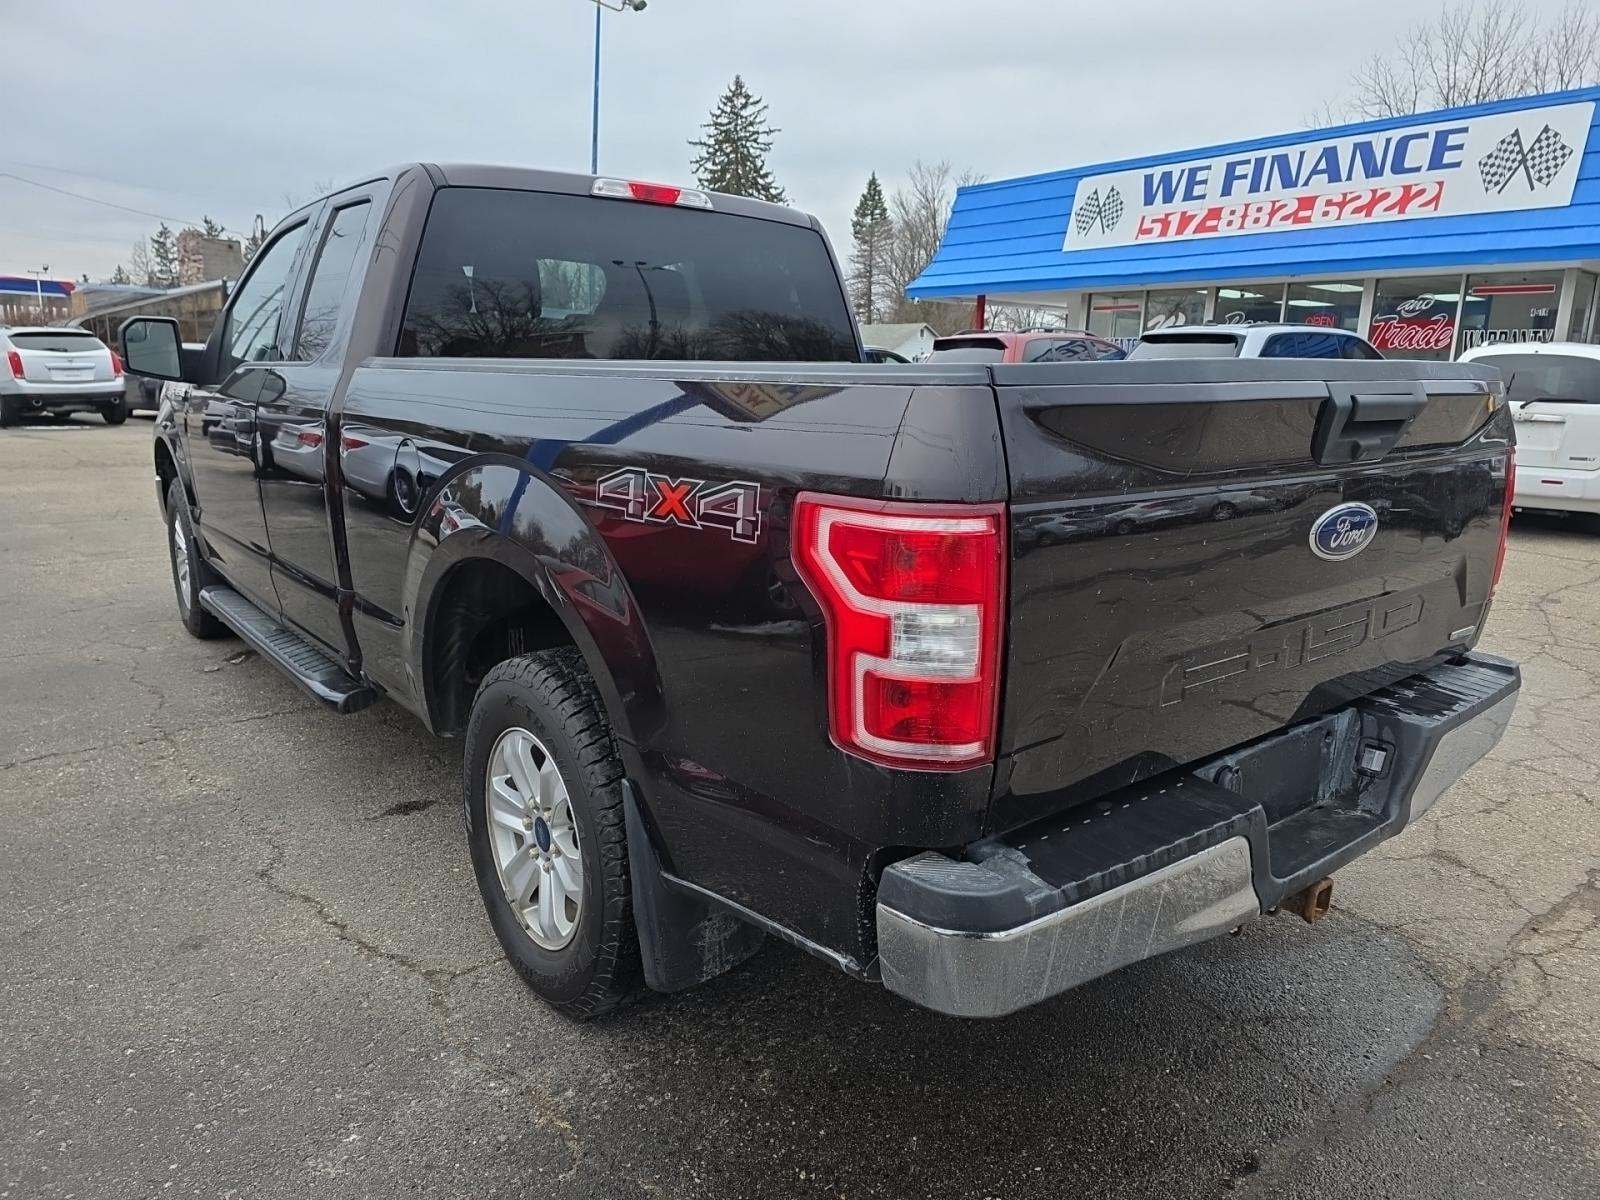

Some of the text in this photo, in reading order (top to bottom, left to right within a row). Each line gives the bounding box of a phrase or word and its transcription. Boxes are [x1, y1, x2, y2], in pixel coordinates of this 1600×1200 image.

[1143, 126, 1469, 207] WE FINANCE
[1137, 181, 1443, 240] 517-882-6222
[1305, 315, 1336, 328] OPEN
[1371, 313, 1454, 349] Trade
[1330, 514, 1369, 548] Ford
